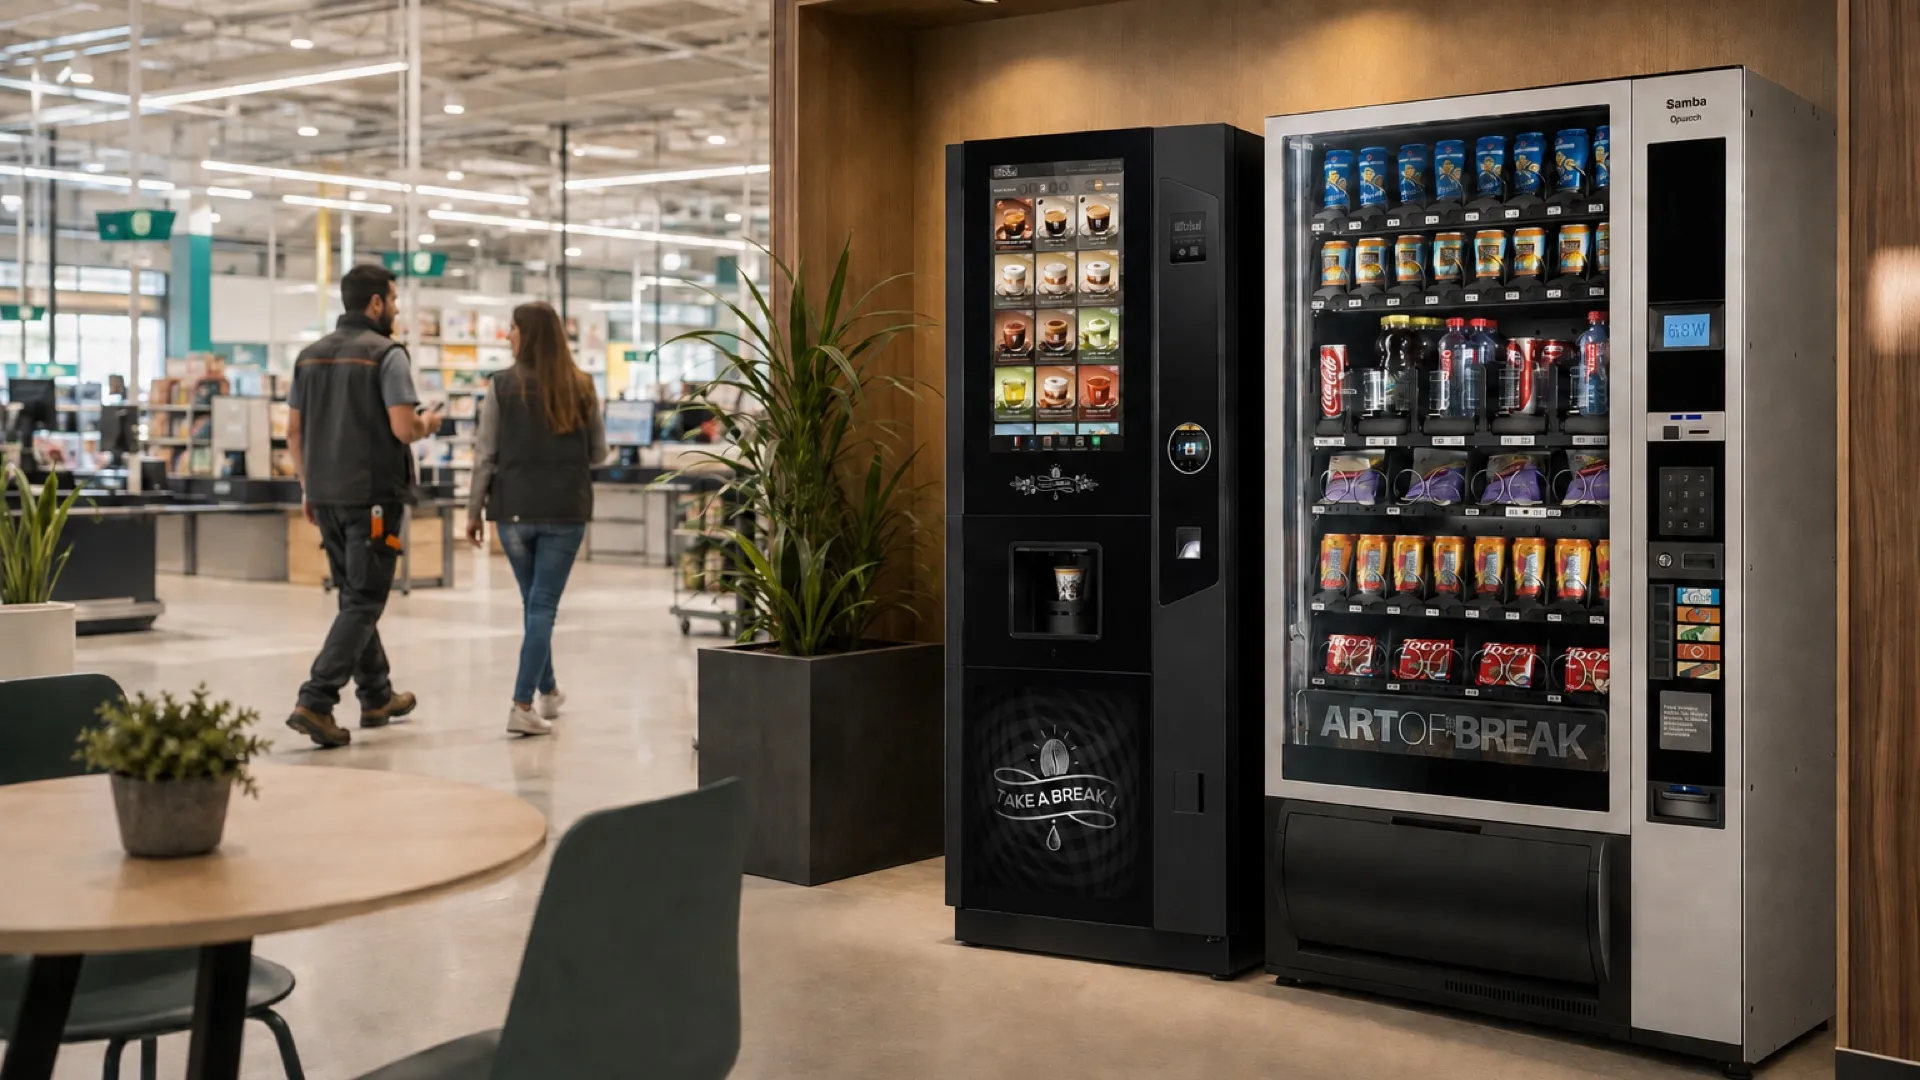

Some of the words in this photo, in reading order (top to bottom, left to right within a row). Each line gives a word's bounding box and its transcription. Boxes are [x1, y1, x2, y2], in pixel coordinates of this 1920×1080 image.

[1666, 97, 1707, 110] Samba
[1320, 705, 1399, 741] ART
[1399, 711, 1446, 746] OF
[1455, 715, 1588, 760] BREAK
[997, 788, 1035, 809] TAKE
[1038, 791, 1050, 806] A
[1050, 786, 1107, 805] BREAK
